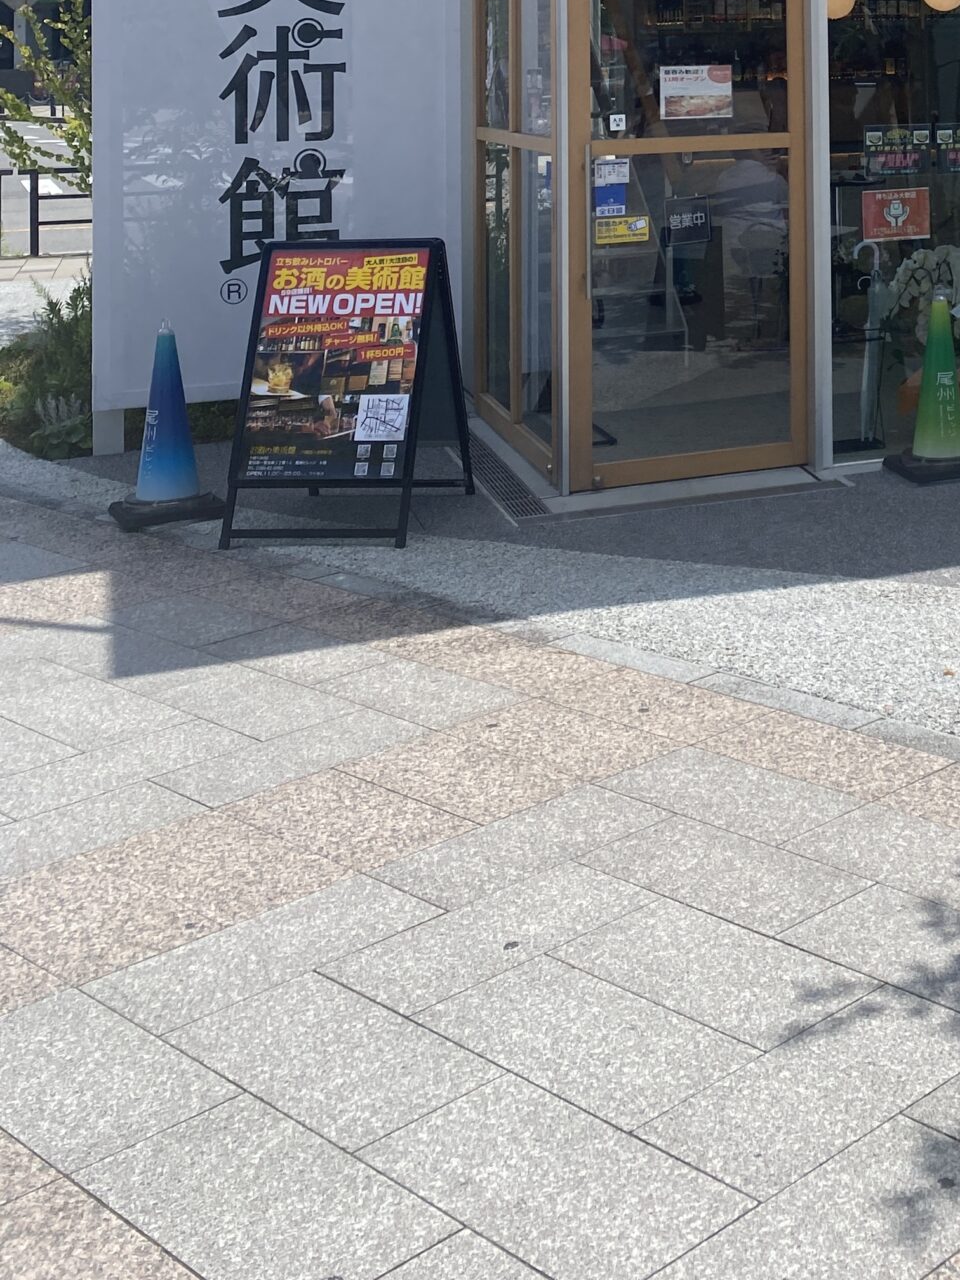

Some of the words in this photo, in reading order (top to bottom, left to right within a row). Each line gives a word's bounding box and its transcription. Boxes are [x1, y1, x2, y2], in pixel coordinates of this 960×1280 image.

[669, 212, 706, 229] 営業中
[272, 267, 426, 291] お酒の美術館
[268, 294, 333, 315] NEW
[333, 293, 423, 314] OPEN!
